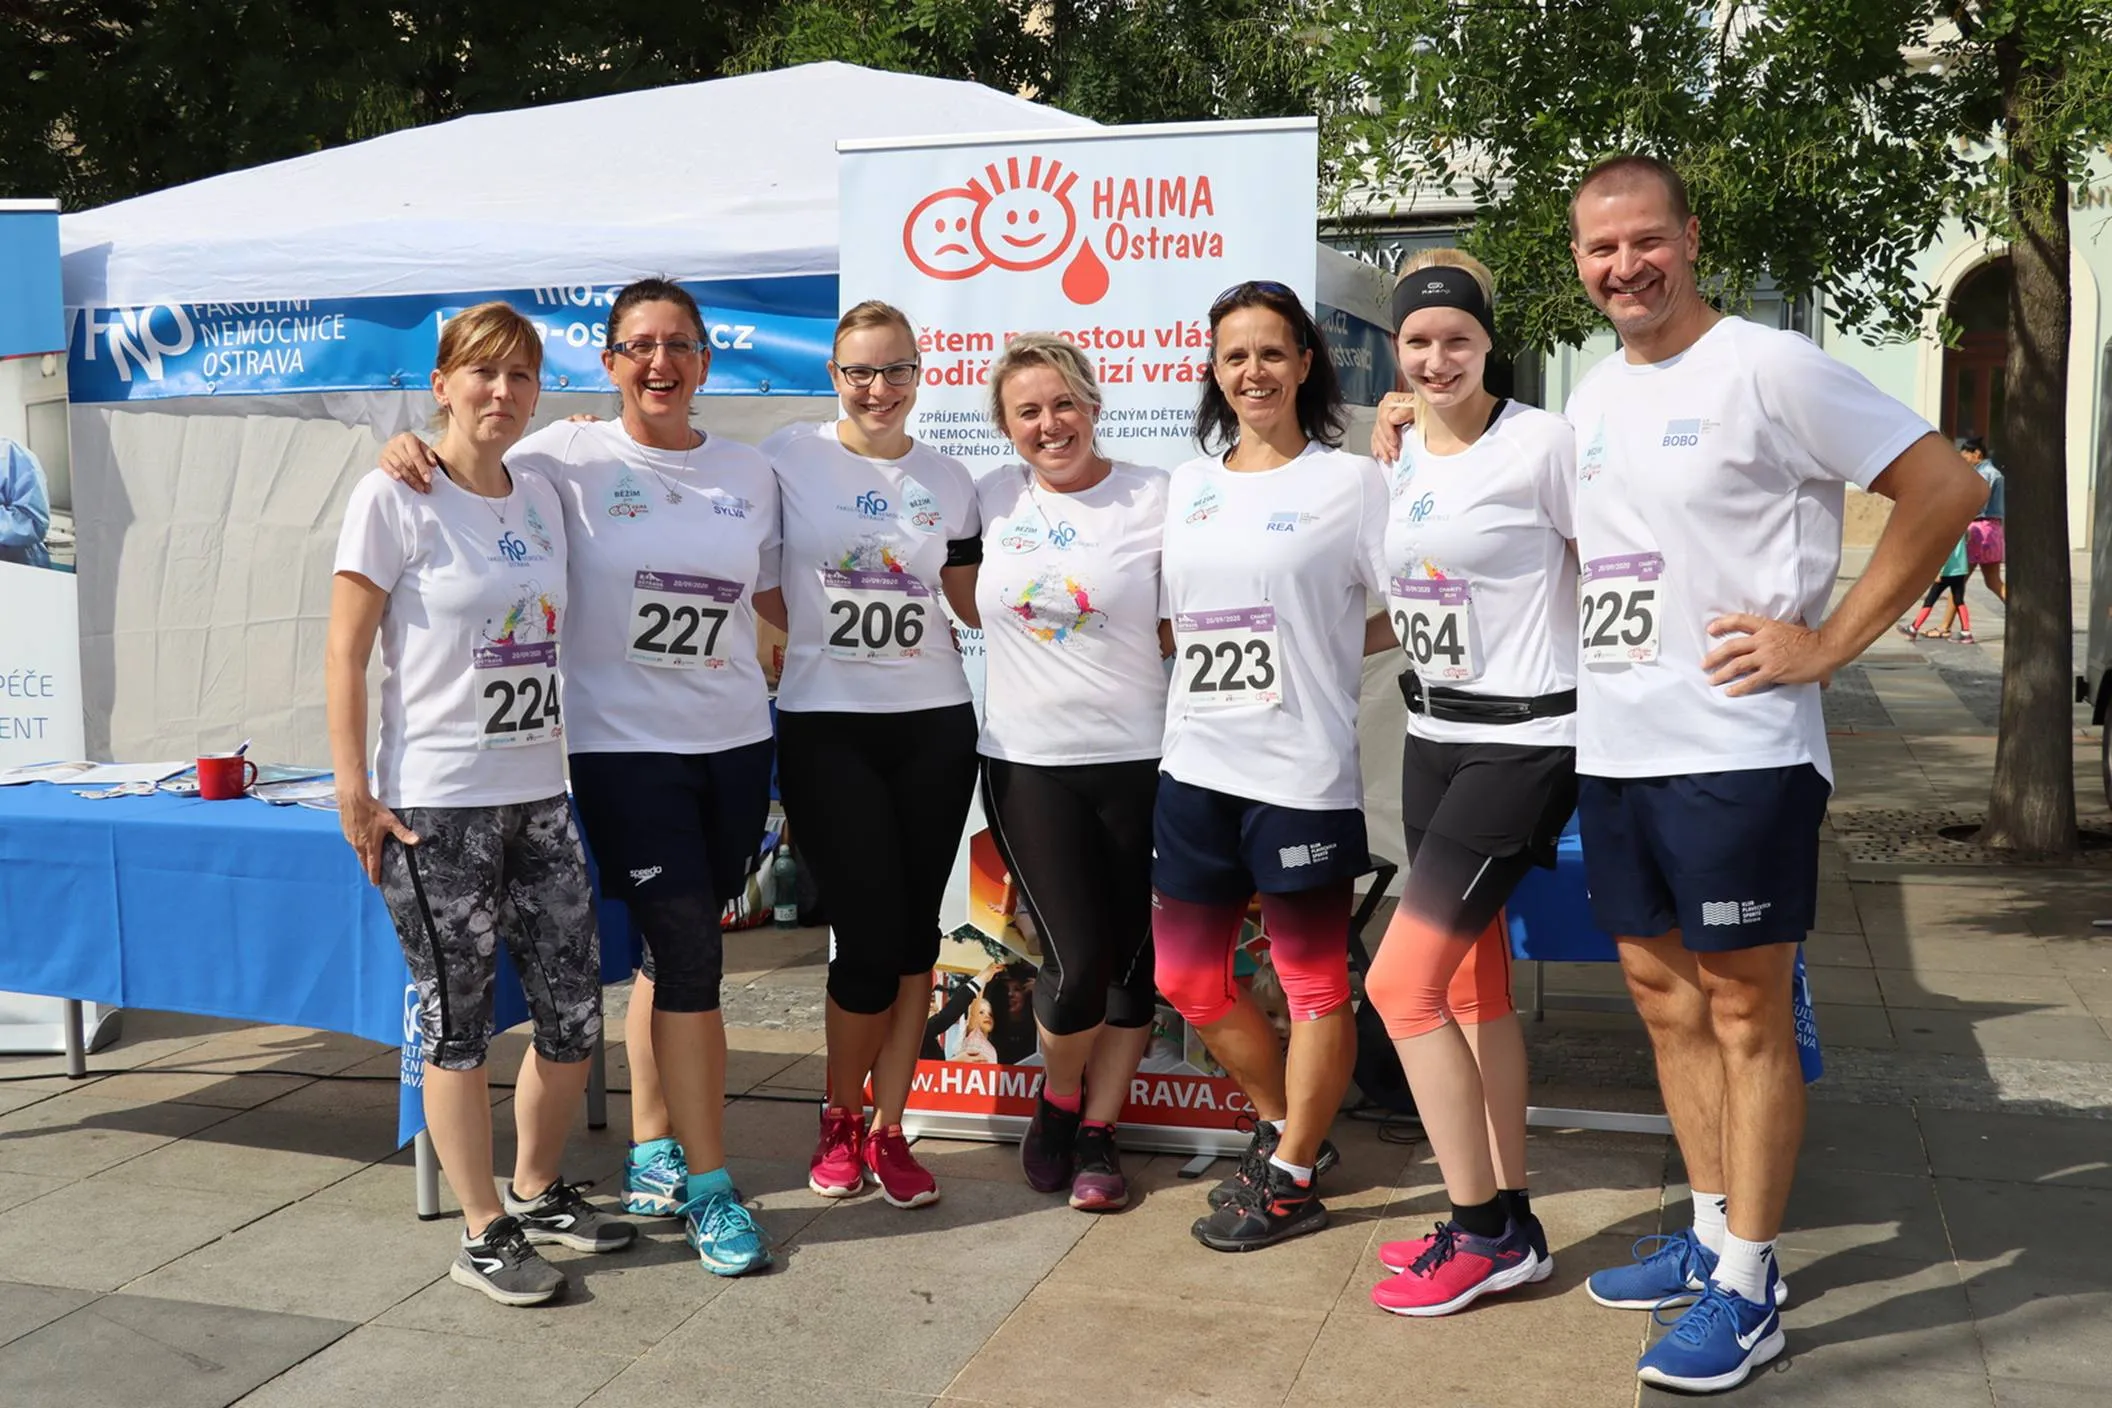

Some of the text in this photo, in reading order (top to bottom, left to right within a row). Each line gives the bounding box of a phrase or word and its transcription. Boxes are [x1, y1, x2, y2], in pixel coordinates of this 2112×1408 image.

[1093, 175, 1214, 219] HAIMA
[1105, 223, 1223, 261] Ostrava
[200, 314, 346, 347] NEMOCNICE
[917, 327, 994, 353] ětem
[1154, 320, 1213, 348] vlás
[203, 348, 304, 377] OSTRAVA
[920, 359, 992, 386] odič
[1142, 355, 1208, 382] vrás
[919, 409, 990, 424] ZPŘÍJEMŇU
[1099, 408, 1148, 421] OCNÝM
[929, 428, 1002, 440] NEMOCNIC
[1116, 426, 1158, 438] JEJICH
[1161, 424, 1197, 438] NÁVR
[1661, 435, 1699, 447] BOBO
[713, 505, 747, 520] SYLVA
[1266, 522, 1295, 532] REA
[633, 603, 729, 657] 227
[829, 599, 925, 649] 206
[1394, 609, 1465, 666] 264
[1186, 639, 1275, 693] 223
[483, 674, 561, 734] 224
[0, 717, 48, 739] ENT
[630, 865, 663, 878] speedo
